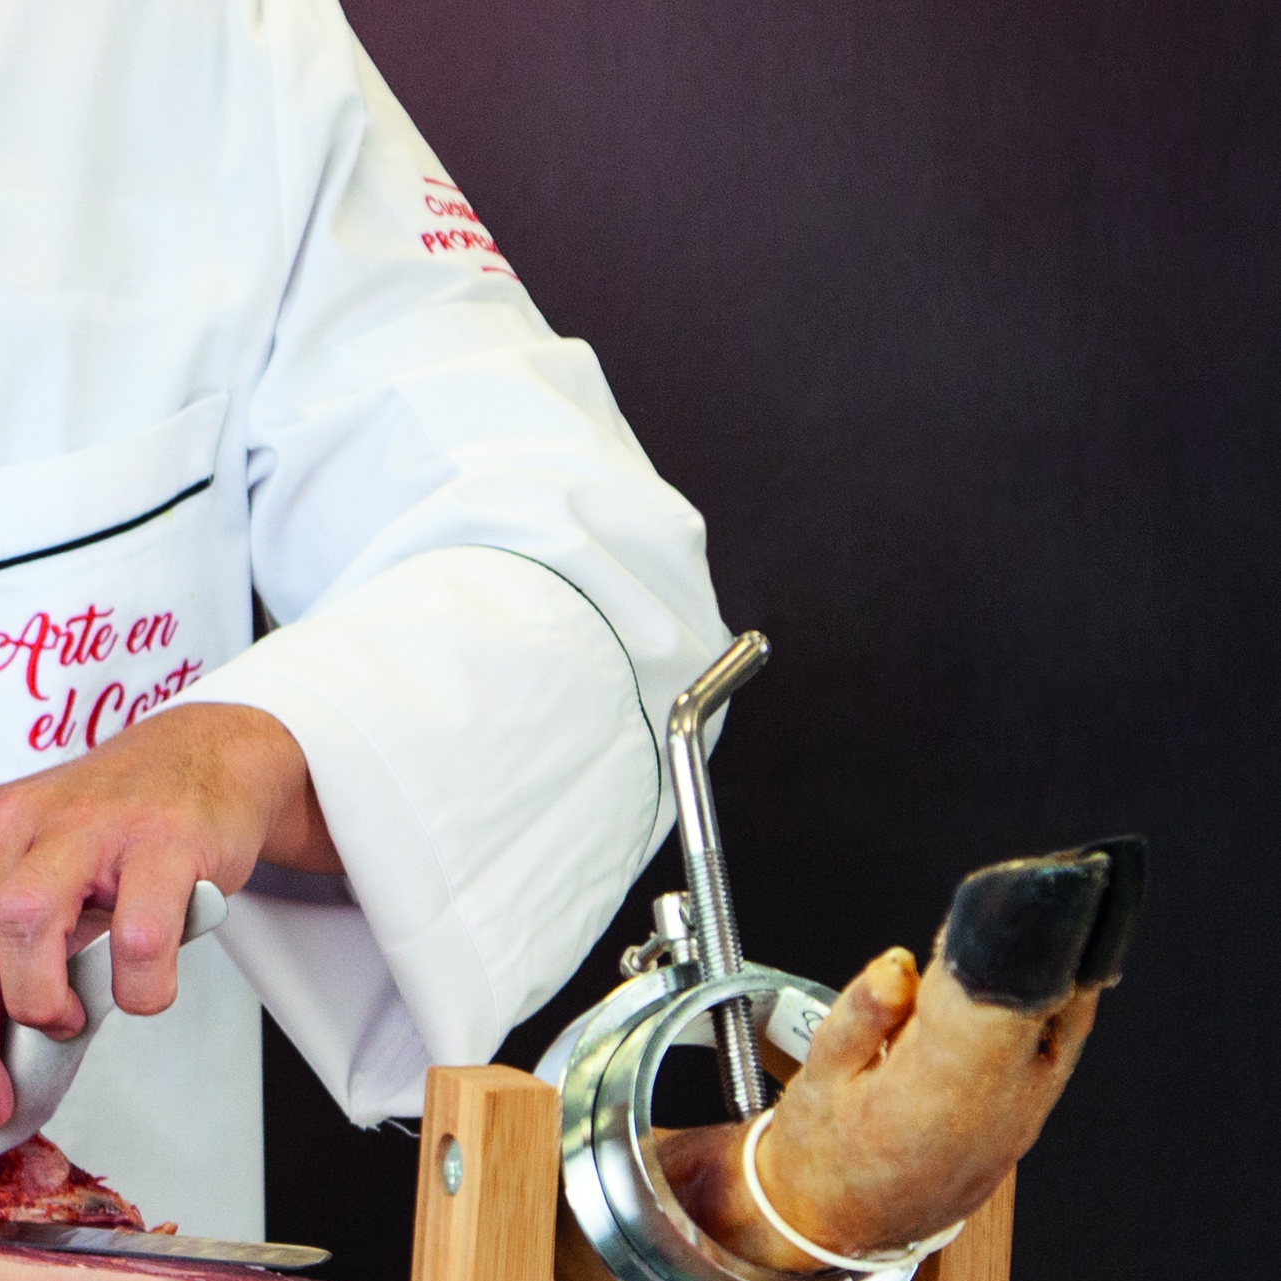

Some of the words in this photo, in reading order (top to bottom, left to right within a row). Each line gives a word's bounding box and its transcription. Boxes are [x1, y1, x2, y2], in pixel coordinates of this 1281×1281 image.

[126, 610, 179, 655] en
[28, 687, 77, 752] el
[85, 658, 204, 751] Cort
